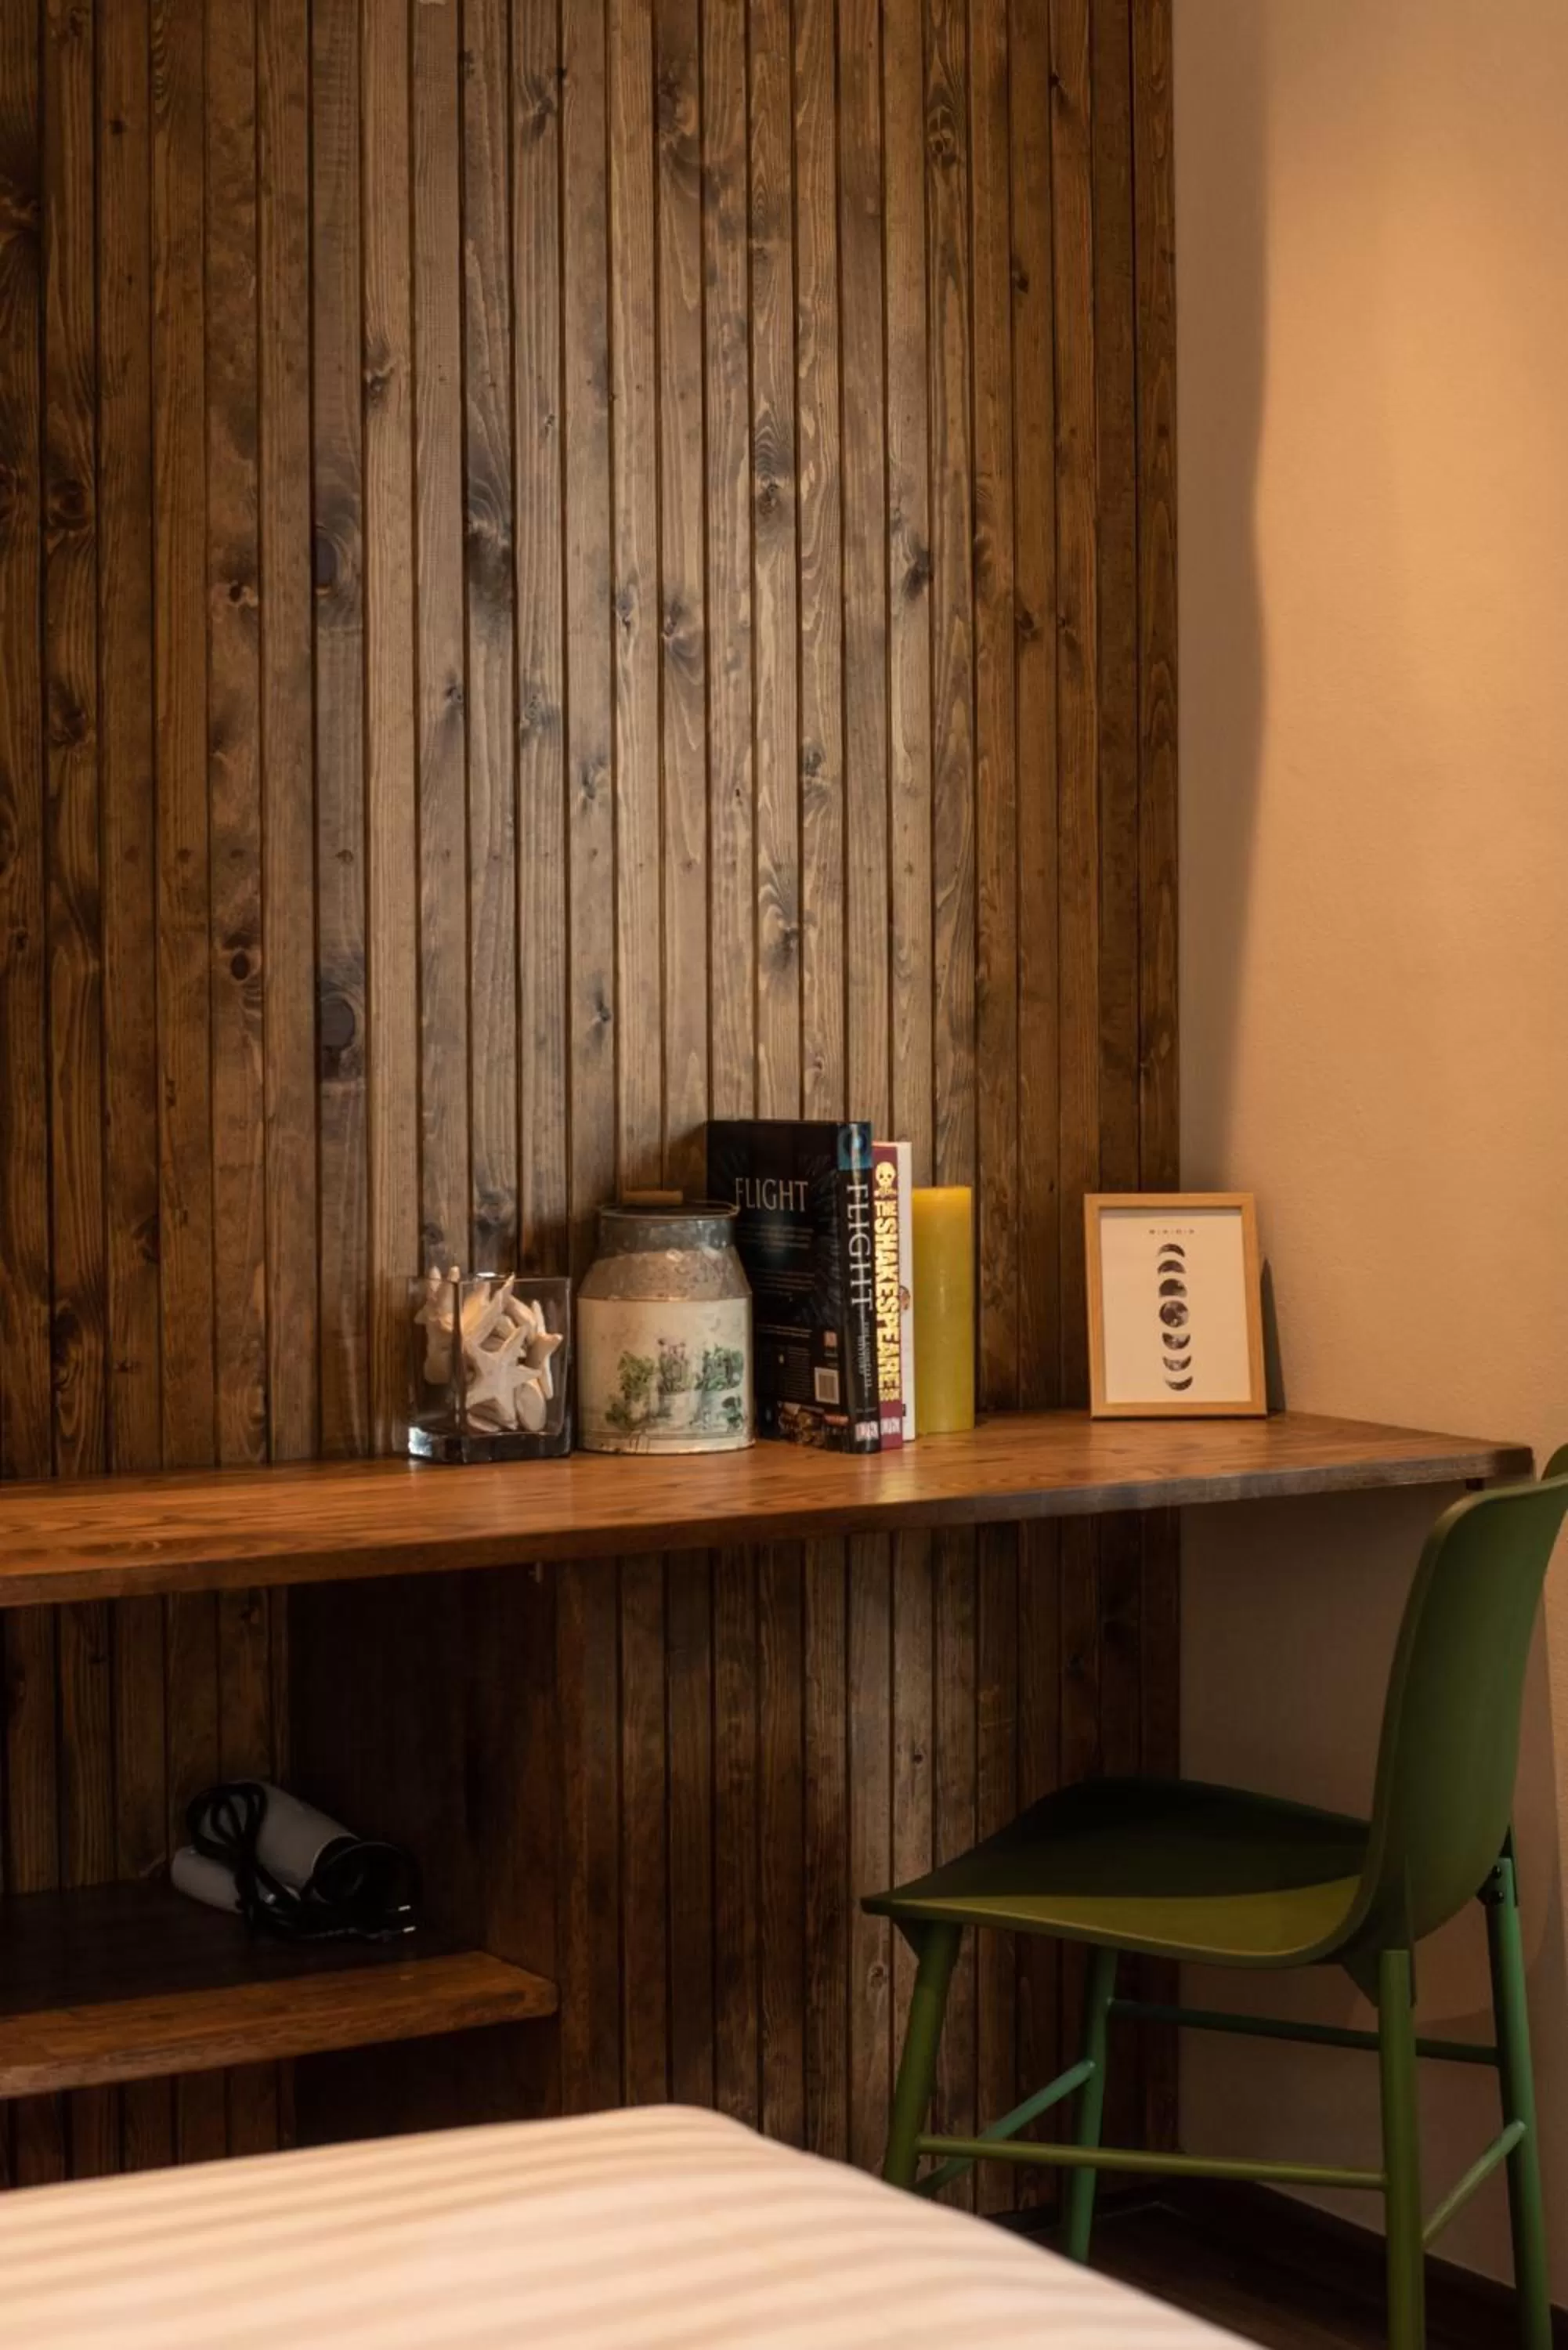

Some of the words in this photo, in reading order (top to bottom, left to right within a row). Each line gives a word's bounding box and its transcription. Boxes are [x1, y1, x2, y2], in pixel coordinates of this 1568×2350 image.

[735, 1177, 809, 1213] FLIGHT
[846, 1184, 873, 1311] FLIGHT
[873, 1217, 900, 1388] SHAKESPEARE
